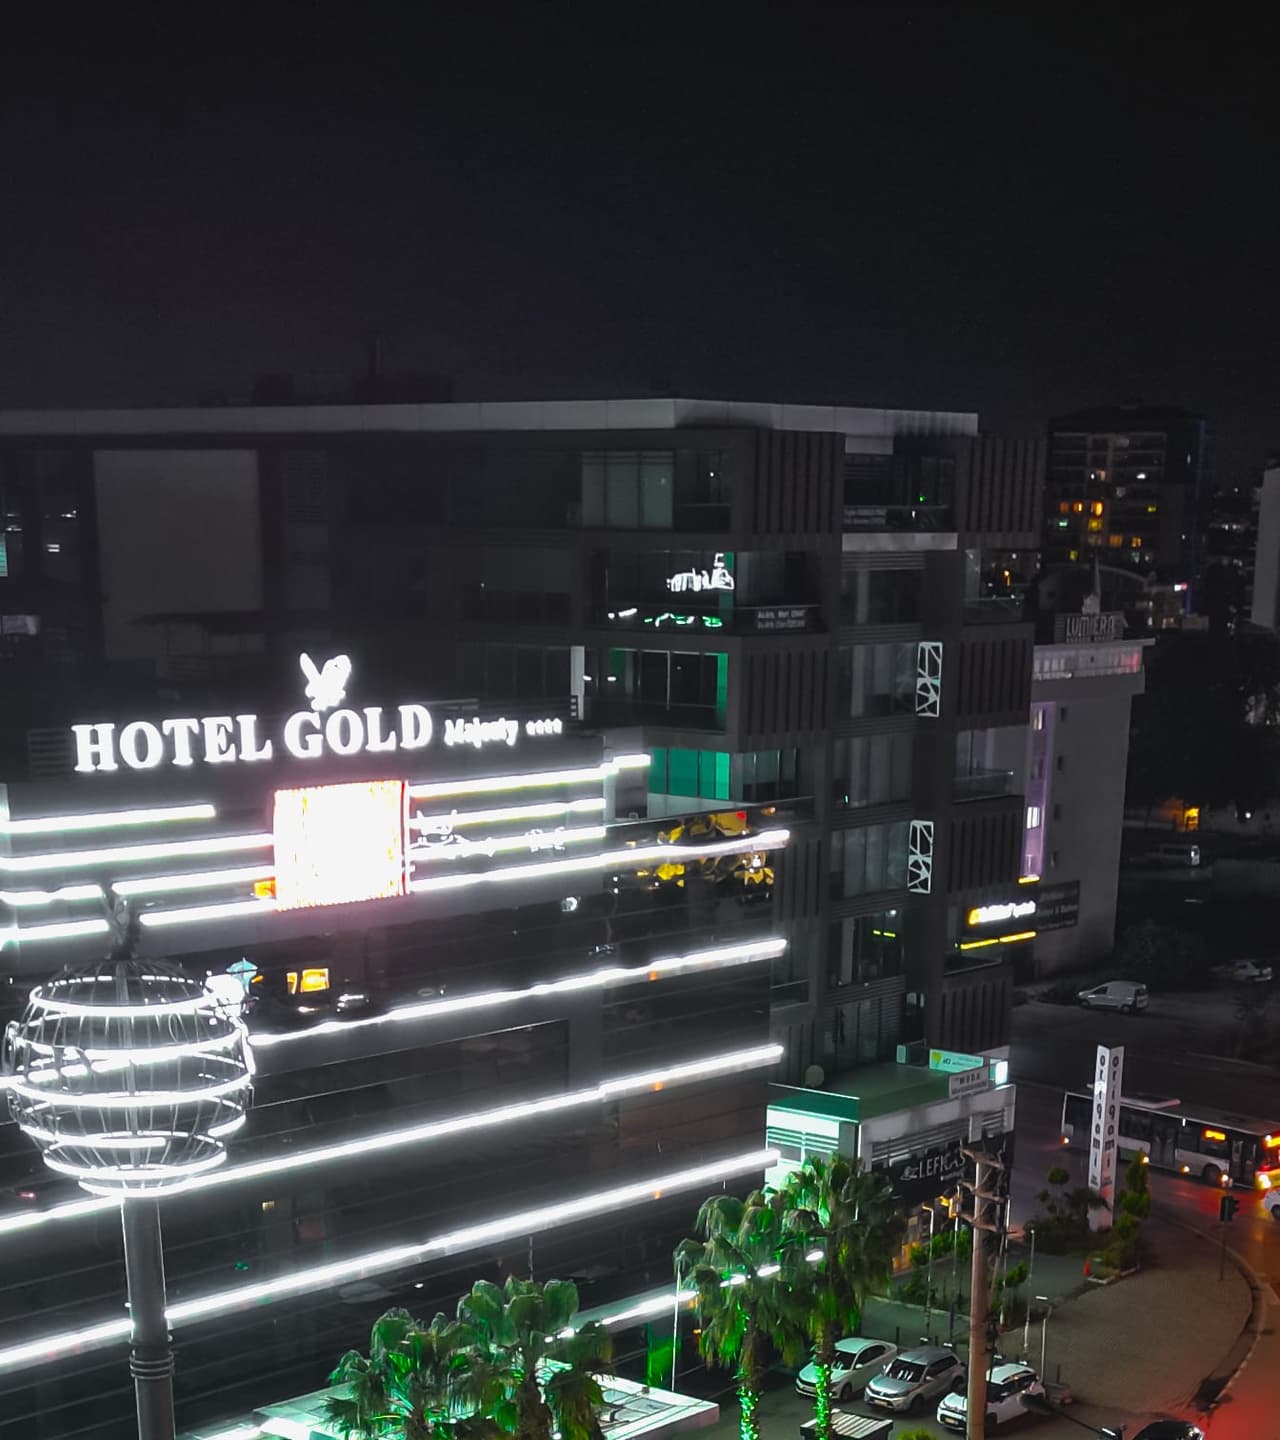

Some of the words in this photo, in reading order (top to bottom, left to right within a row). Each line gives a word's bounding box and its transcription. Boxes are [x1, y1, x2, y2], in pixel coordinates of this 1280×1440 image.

[72, 715, 272, 772] HOTEL
[284, 706, 432, 759] GOLD
[1105, 1056, 1120, 1169] origami
